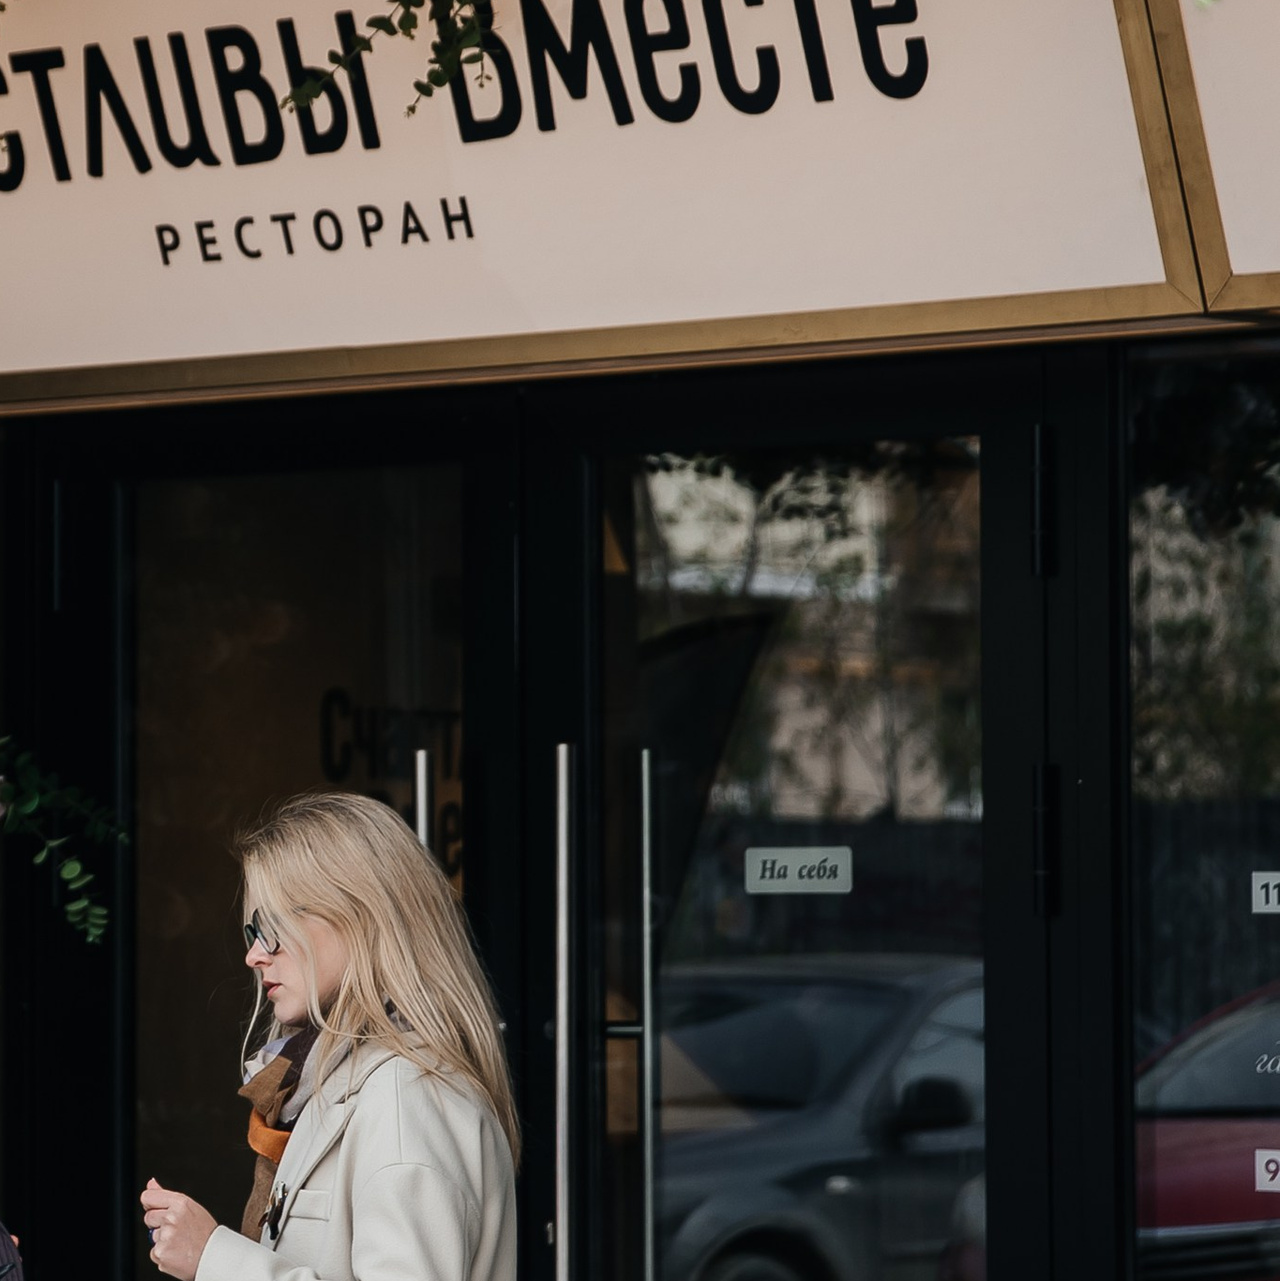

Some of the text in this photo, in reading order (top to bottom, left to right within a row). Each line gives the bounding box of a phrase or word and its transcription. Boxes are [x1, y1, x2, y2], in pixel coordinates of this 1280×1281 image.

[154, 194, 475, 267] РЕСТОРАН
[759, 856, 839, 881] На себя
